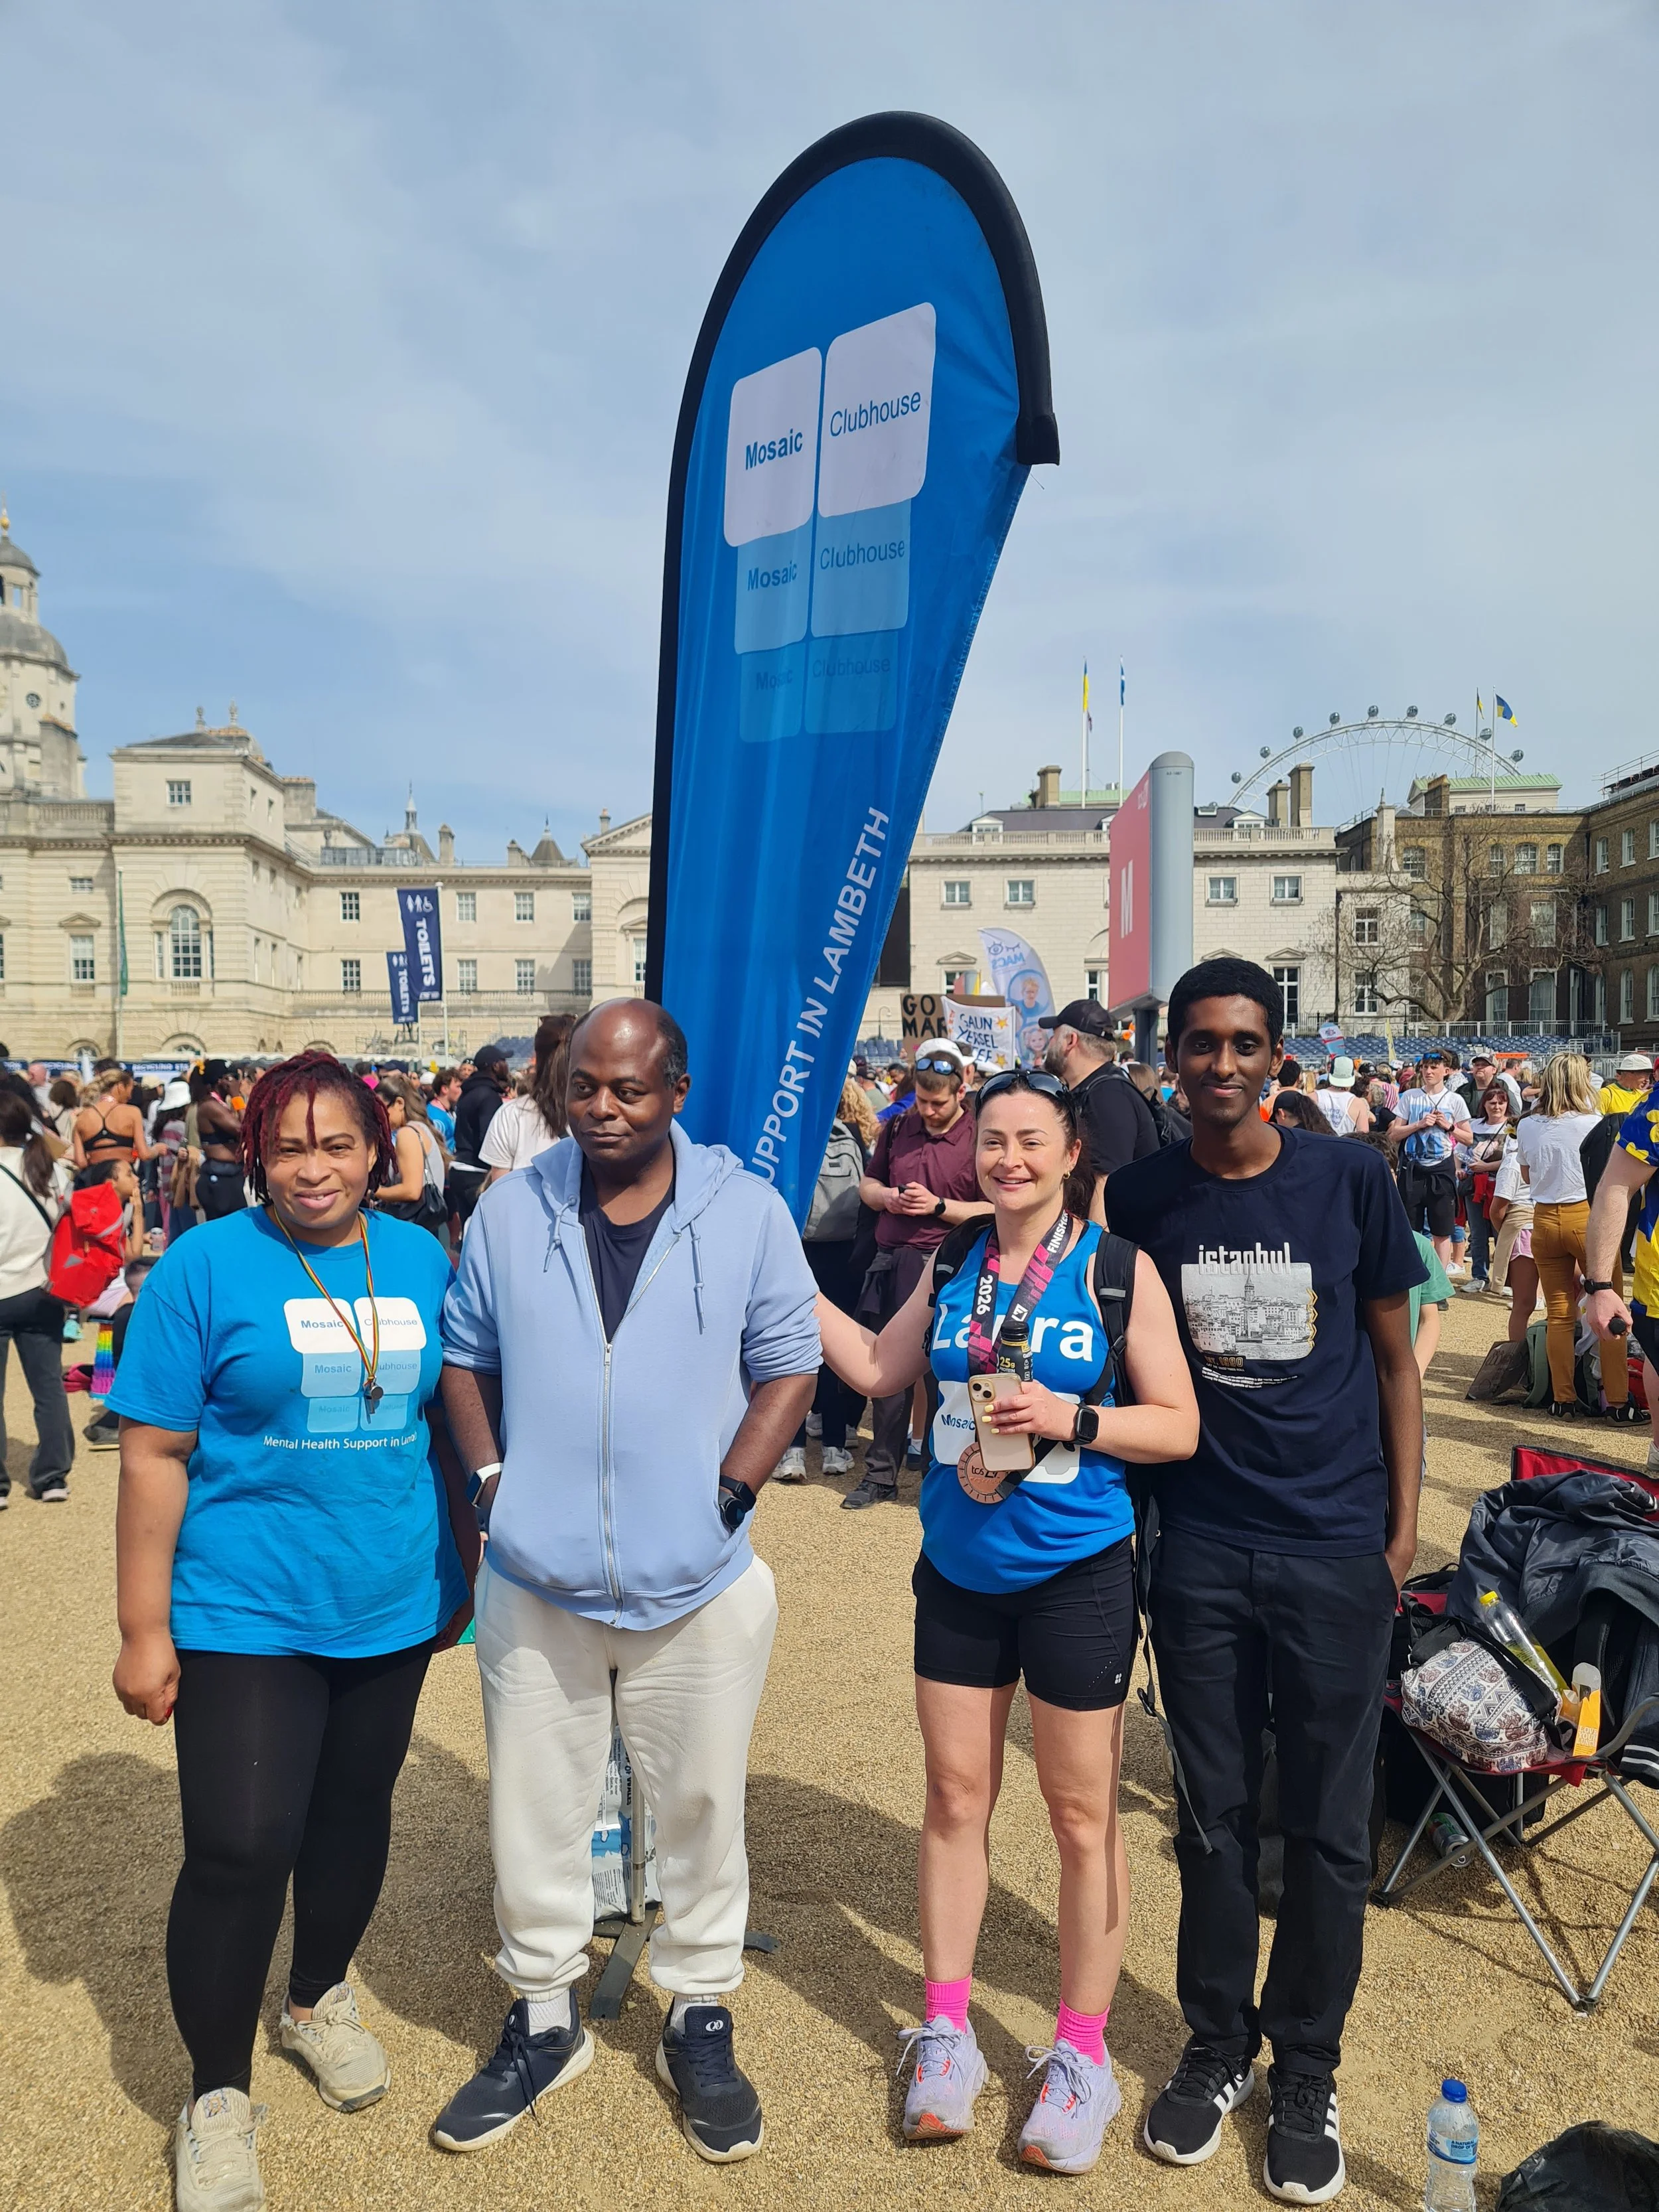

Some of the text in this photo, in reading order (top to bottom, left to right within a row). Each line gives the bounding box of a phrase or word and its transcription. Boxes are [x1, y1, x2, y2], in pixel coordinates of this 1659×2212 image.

[745, 391, 921, 471] Mosaic Clubhouse
[747, 540, 905, 591] Mosaic Clubhouse
[812, 658, 891, 678] Clubhouse
[415, 917, 436, 986] TOILETS
[397, 968, 410, 1014] TOILETS
[751, 806, 889, 1183] UPPORT IN LAMBETH
[902, 995, 936, 1016] GO
[1046, 1209, 1068, 1254] FINISHER
[1198, 1242, 1291, 1275] istanbul
[976, 1274, 993, 1315] 2026
[301, 1319, 344, 1329] Mosaic
[315, 1363, 417, 1373] Mosaic lubhouse
[999, 1356, 1015, 1368] 25g
[941, 1414, 975, 1431] Mosaic
[263, 1436, 298, 1449] Mental
[301, 1438, 340, 1449] Health
[343, 1437, 388, 1451] Support
[390, 1436, 399, 1447] in
[972, 1465, 984, 1476] tcs
